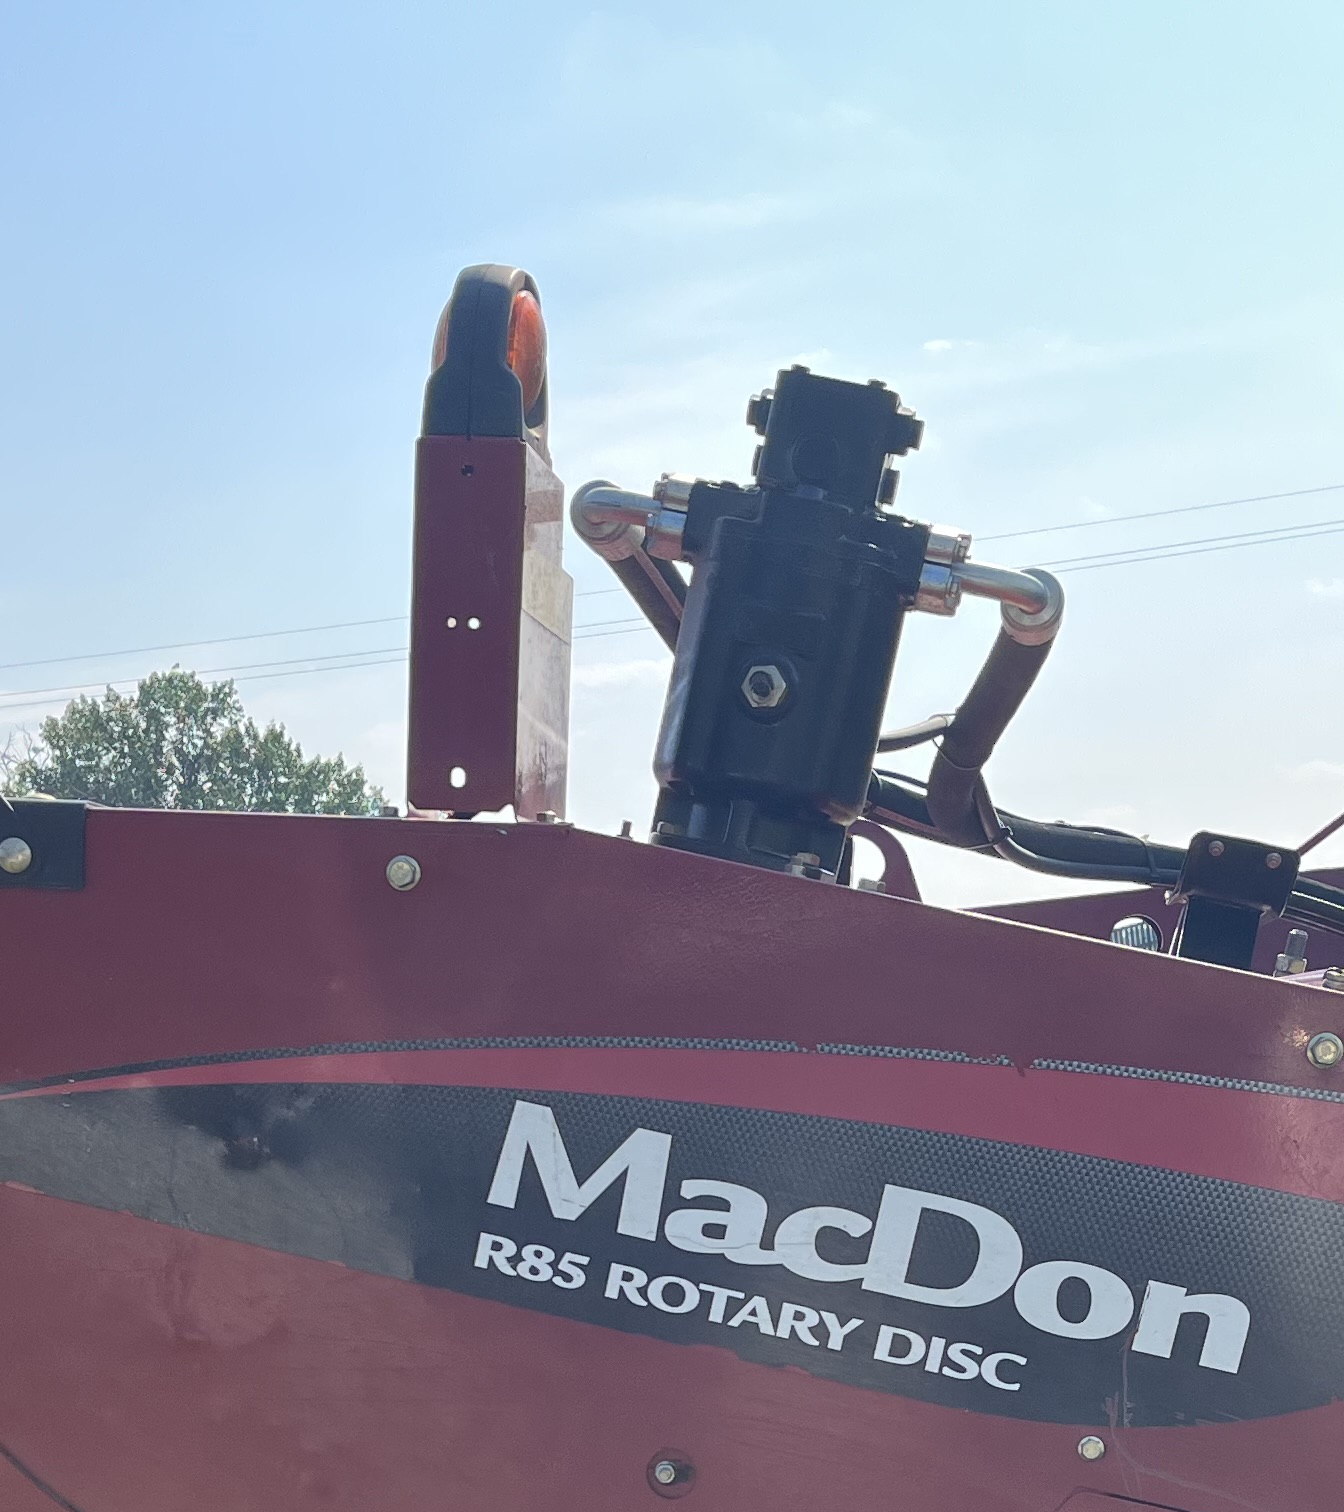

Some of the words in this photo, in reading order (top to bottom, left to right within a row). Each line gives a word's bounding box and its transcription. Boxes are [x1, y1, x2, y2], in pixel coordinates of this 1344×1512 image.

[475, 1232, 589, 1291] R85
[604, 1263, 864, 1352] ROTARY
[873, 1324, 1028, 1391] DISC
[487, 1099, 1251, 1374] MacDon
